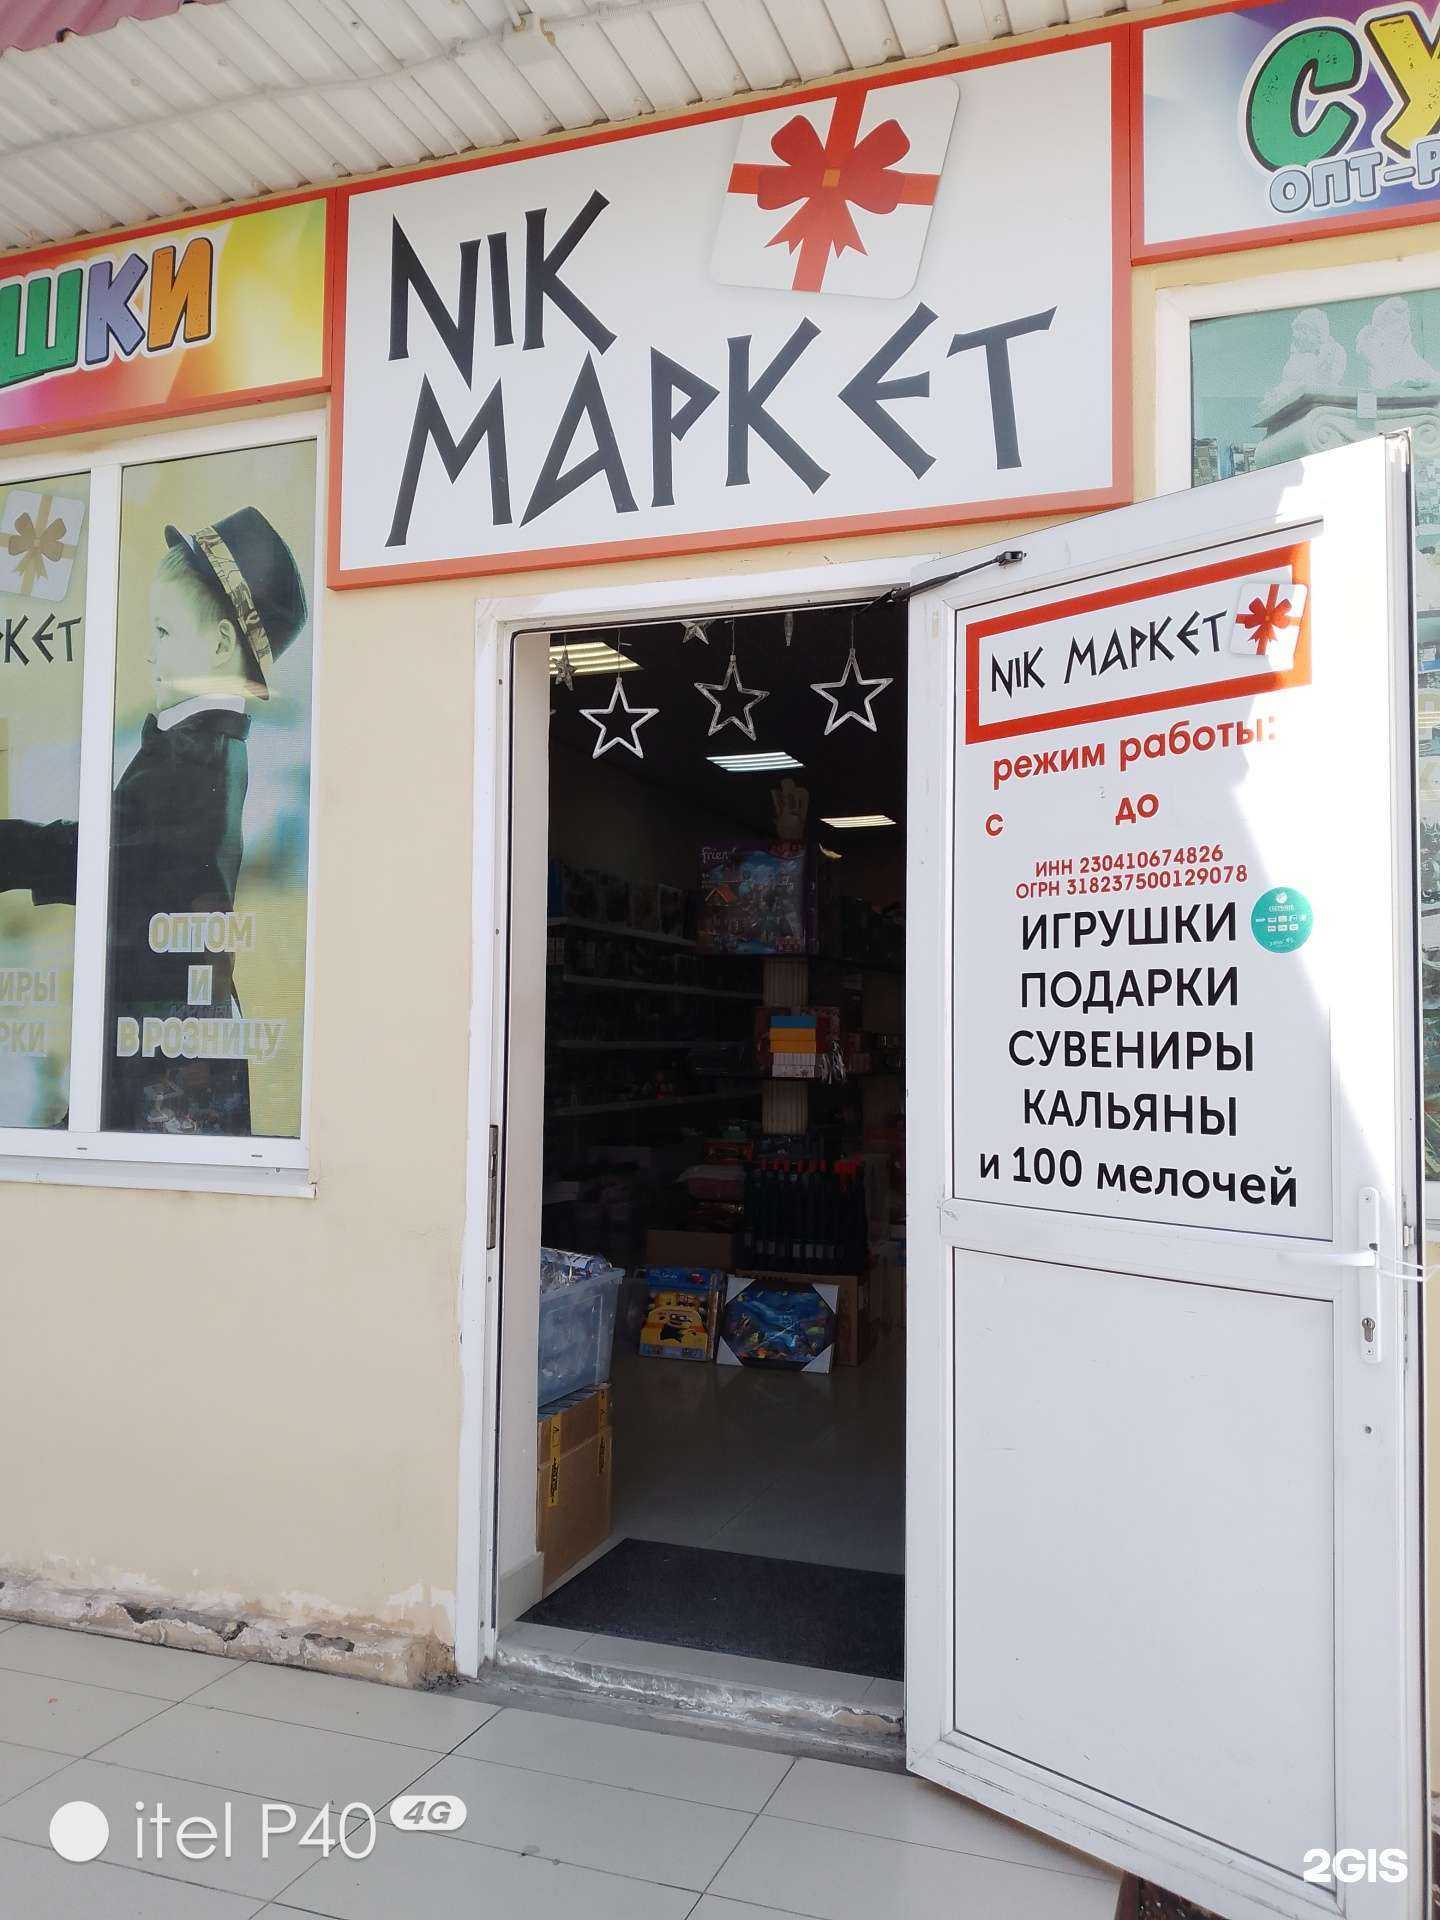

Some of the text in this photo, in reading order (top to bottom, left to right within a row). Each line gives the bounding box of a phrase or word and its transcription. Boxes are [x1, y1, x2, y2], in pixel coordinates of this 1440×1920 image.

[0, 236, 214, 389] ШКИ
[388, 188, 618, 391] NIK
[384, 302, 1058, 547] МАРКЕТ
[0, 612, 82, 667] КЕТ
[991, 609, 1228, 699] NIK МАРКЕТ
[993, 742, 1106, 790] режим
[985, 793, 1160, 837] с до
[1015, 865, 1248, 899] ОГРН 318237500129078
[1035, 844, 1224, 878] ИНН 230410674826
[149, 912, 255, 953] ОПТОМ
[1022, 901, 1237, 950] ИГРУШКИ
[1021, 966, 1238, 1014] ПОДАРКИ
[142, 1017, 287, 1063] РОЗНИЦУ
[1008, 1029, 1254, 1072] СУВЕНИРЫ
[1023, 1088, 1237, 1136] КАЛЬЯНЫ
[980, 1146, 1297, 1208] и 100 мелочей
